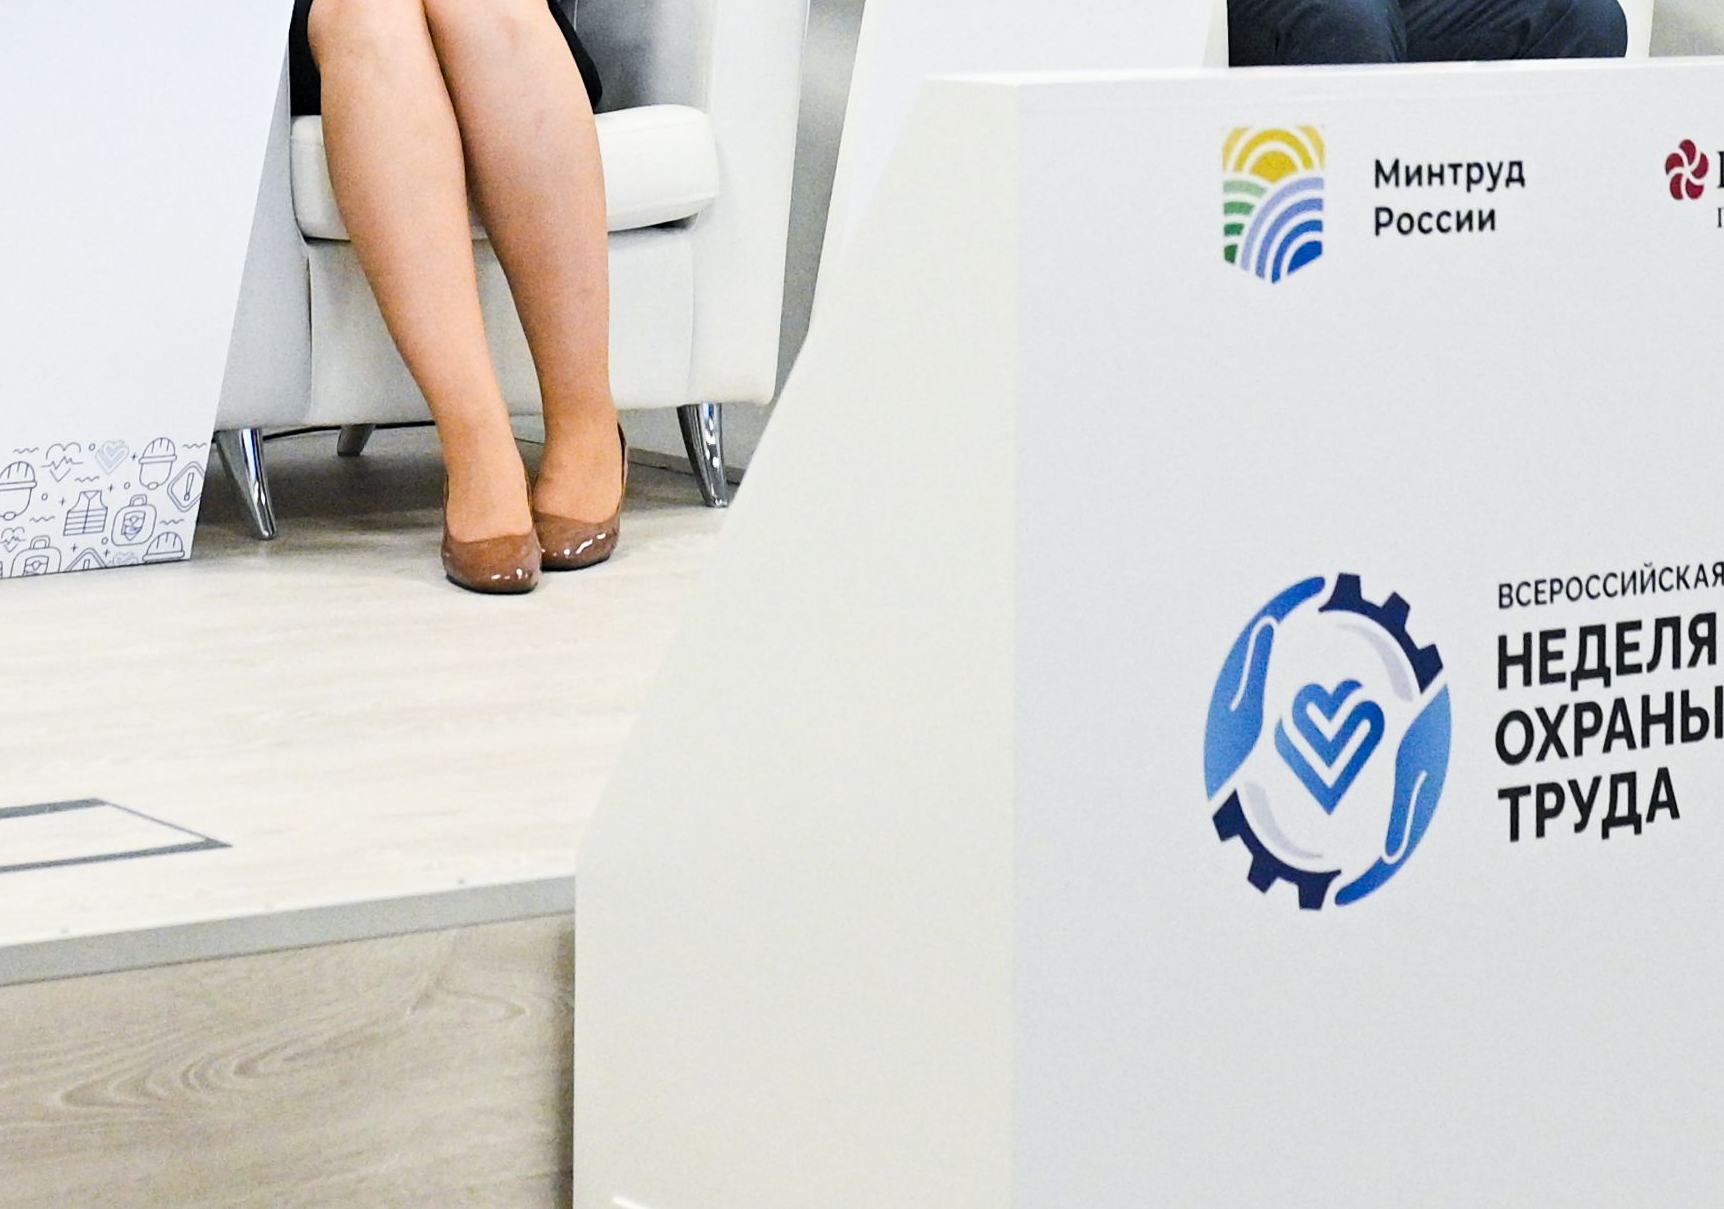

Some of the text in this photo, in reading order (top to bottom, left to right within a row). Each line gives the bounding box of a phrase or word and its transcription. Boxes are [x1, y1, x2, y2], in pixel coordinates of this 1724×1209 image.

[1375, 159, 1525, 192] Минтруд
[1375, 207, 1495, 236] России
[1499, 561, 1724, 609] ВСЕРОССИЙСКАЯ
[1498, 612, 1716, 691] НЕДЕЛЯ
[1495, 685, 1723, 765] ОХРАНЫ
[1498, 767, 1680, 842] ТРУДА
